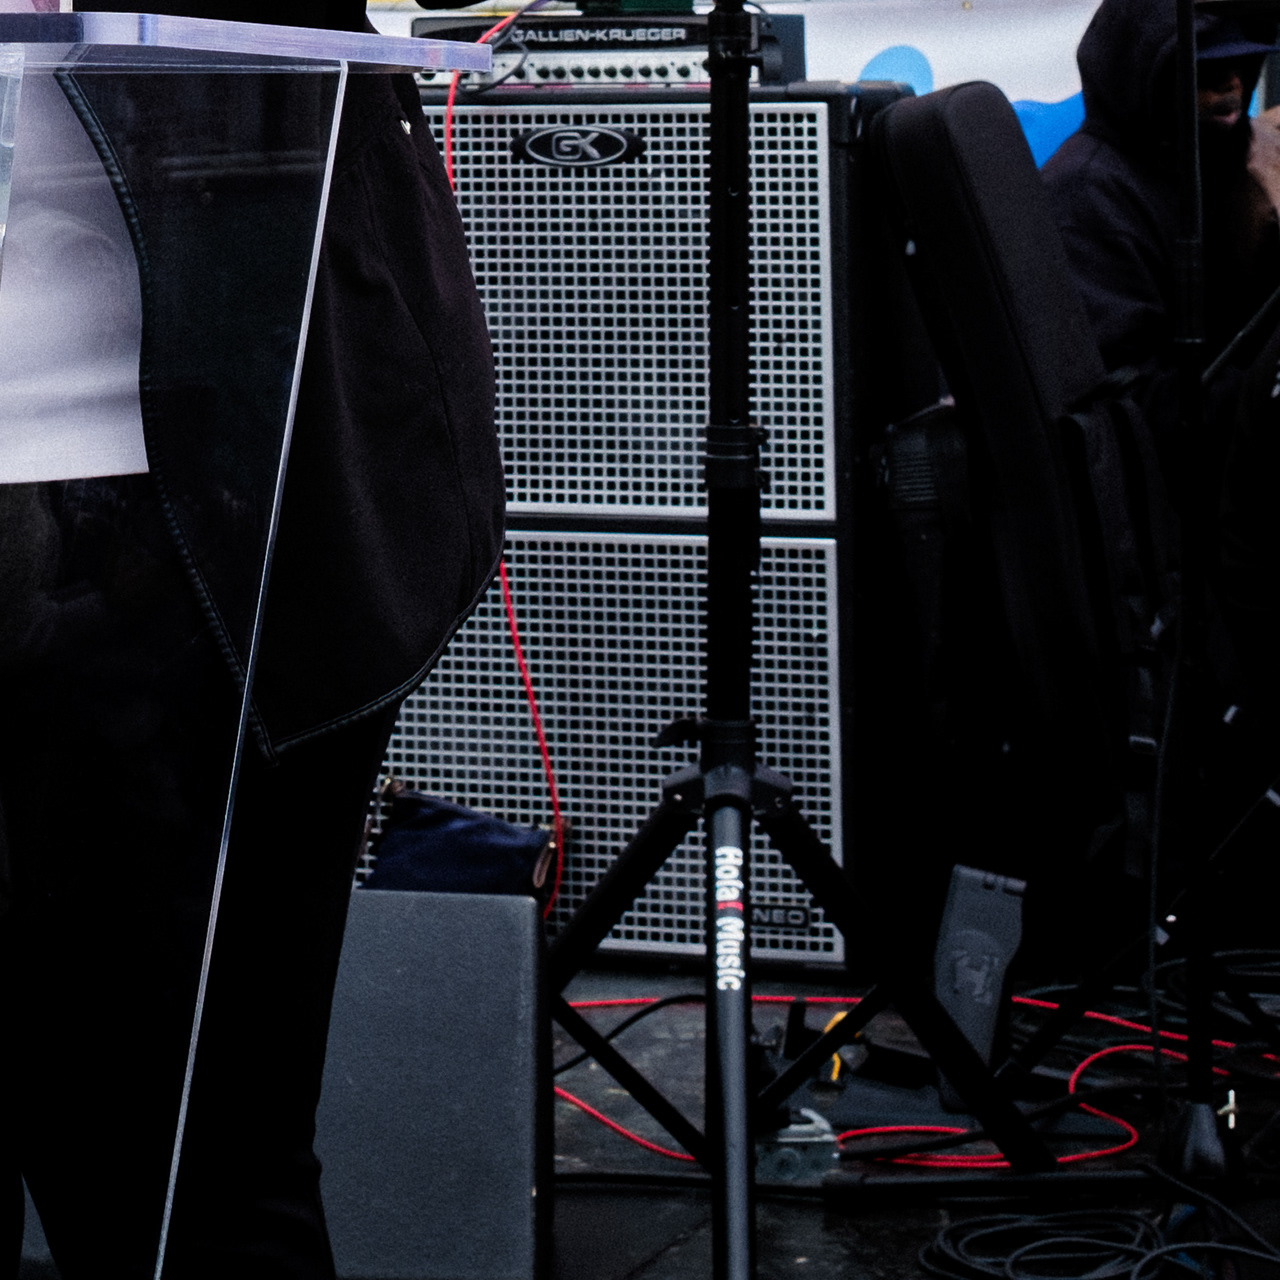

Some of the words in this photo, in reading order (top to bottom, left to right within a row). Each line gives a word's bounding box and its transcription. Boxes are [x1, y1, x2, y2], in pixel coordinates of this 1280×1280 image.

[511, 28, 686, 43] GALLIEN-KRUEGER
[551, 131, 601, 160] GK
[751, 907, 806, 926] NEO
[716, 916, 746, 991] Music
